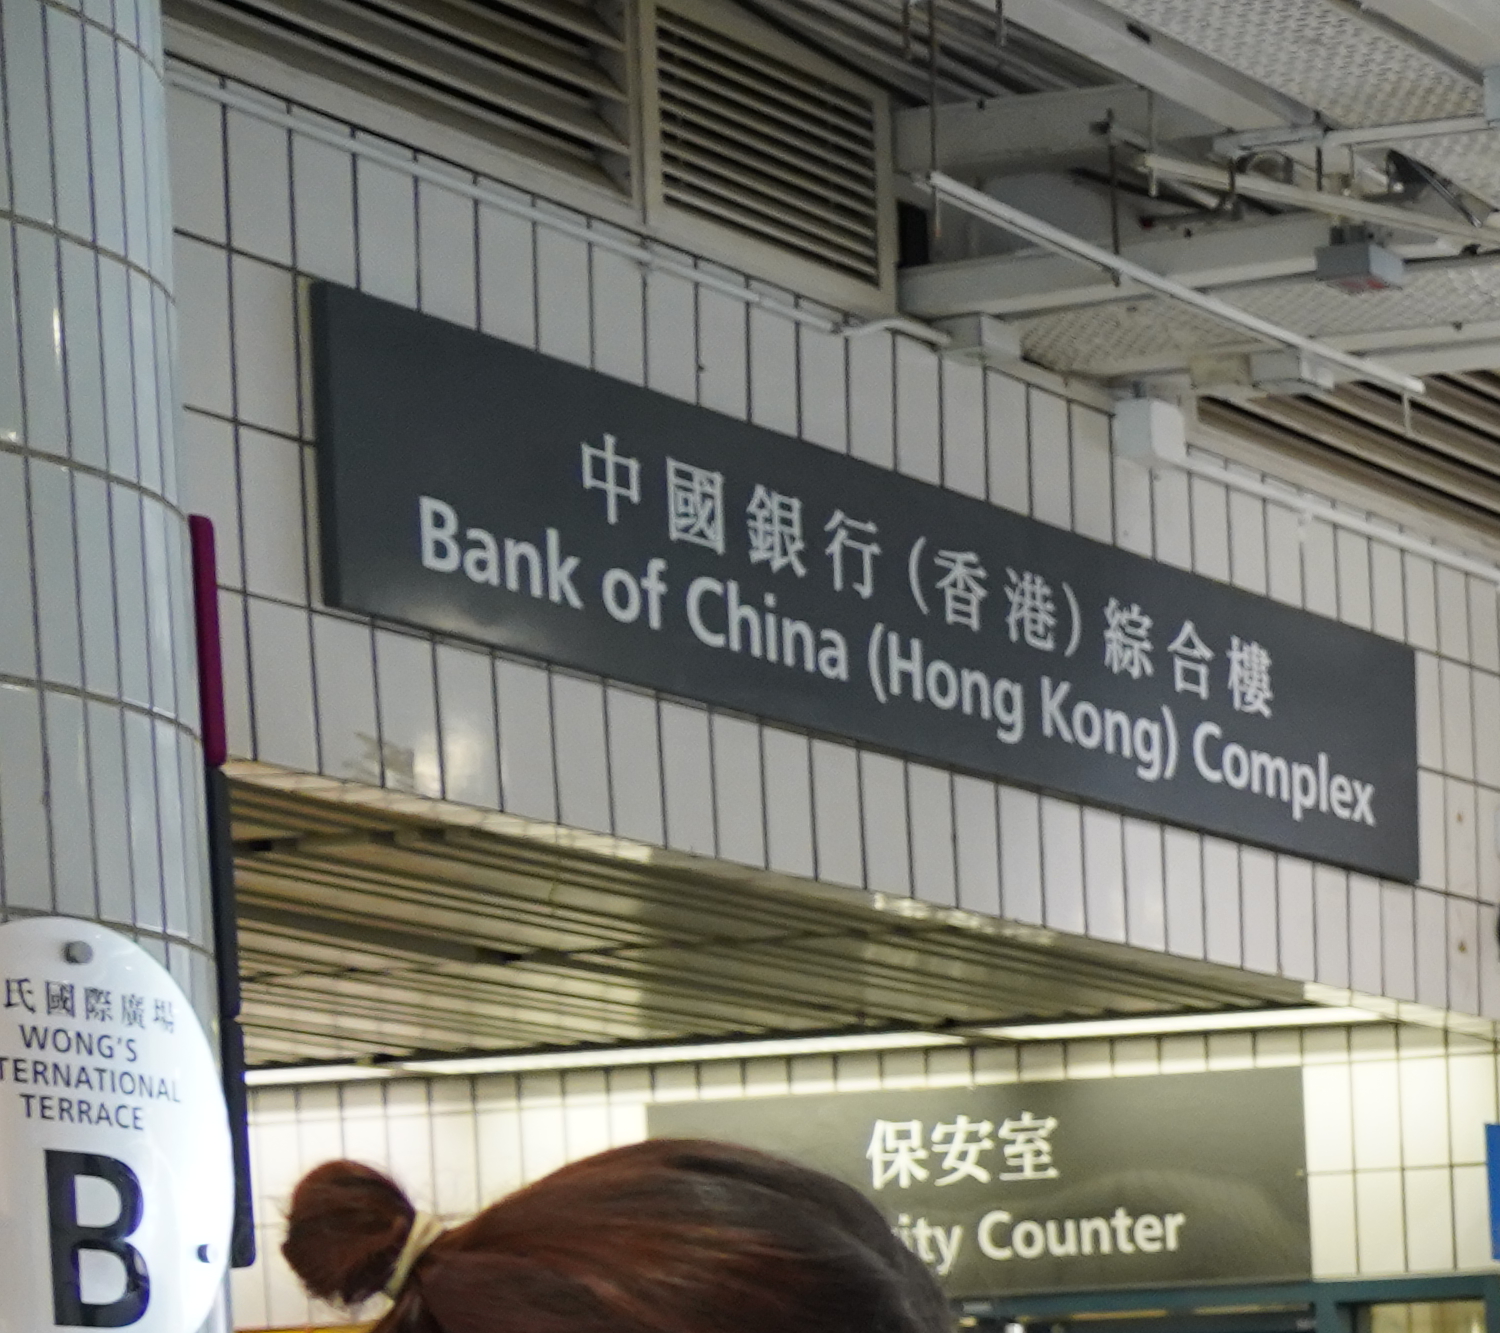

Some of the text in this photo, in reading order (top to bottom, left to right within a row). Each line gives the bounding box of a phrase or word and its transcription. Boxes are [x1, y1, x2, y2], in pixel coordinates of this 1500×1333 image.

[419, 494, 1377, 827] Bank of China (Hong Kong) Complex
[19, 1024, 138, 1062] WONG'S
[20, 1093, 145, 1131] TERRACE
[866, 1111, 1060, 1190] 保安室
[44, 1149, 151, 1329] B
[977, 1207, 1187, 1261] Counter
